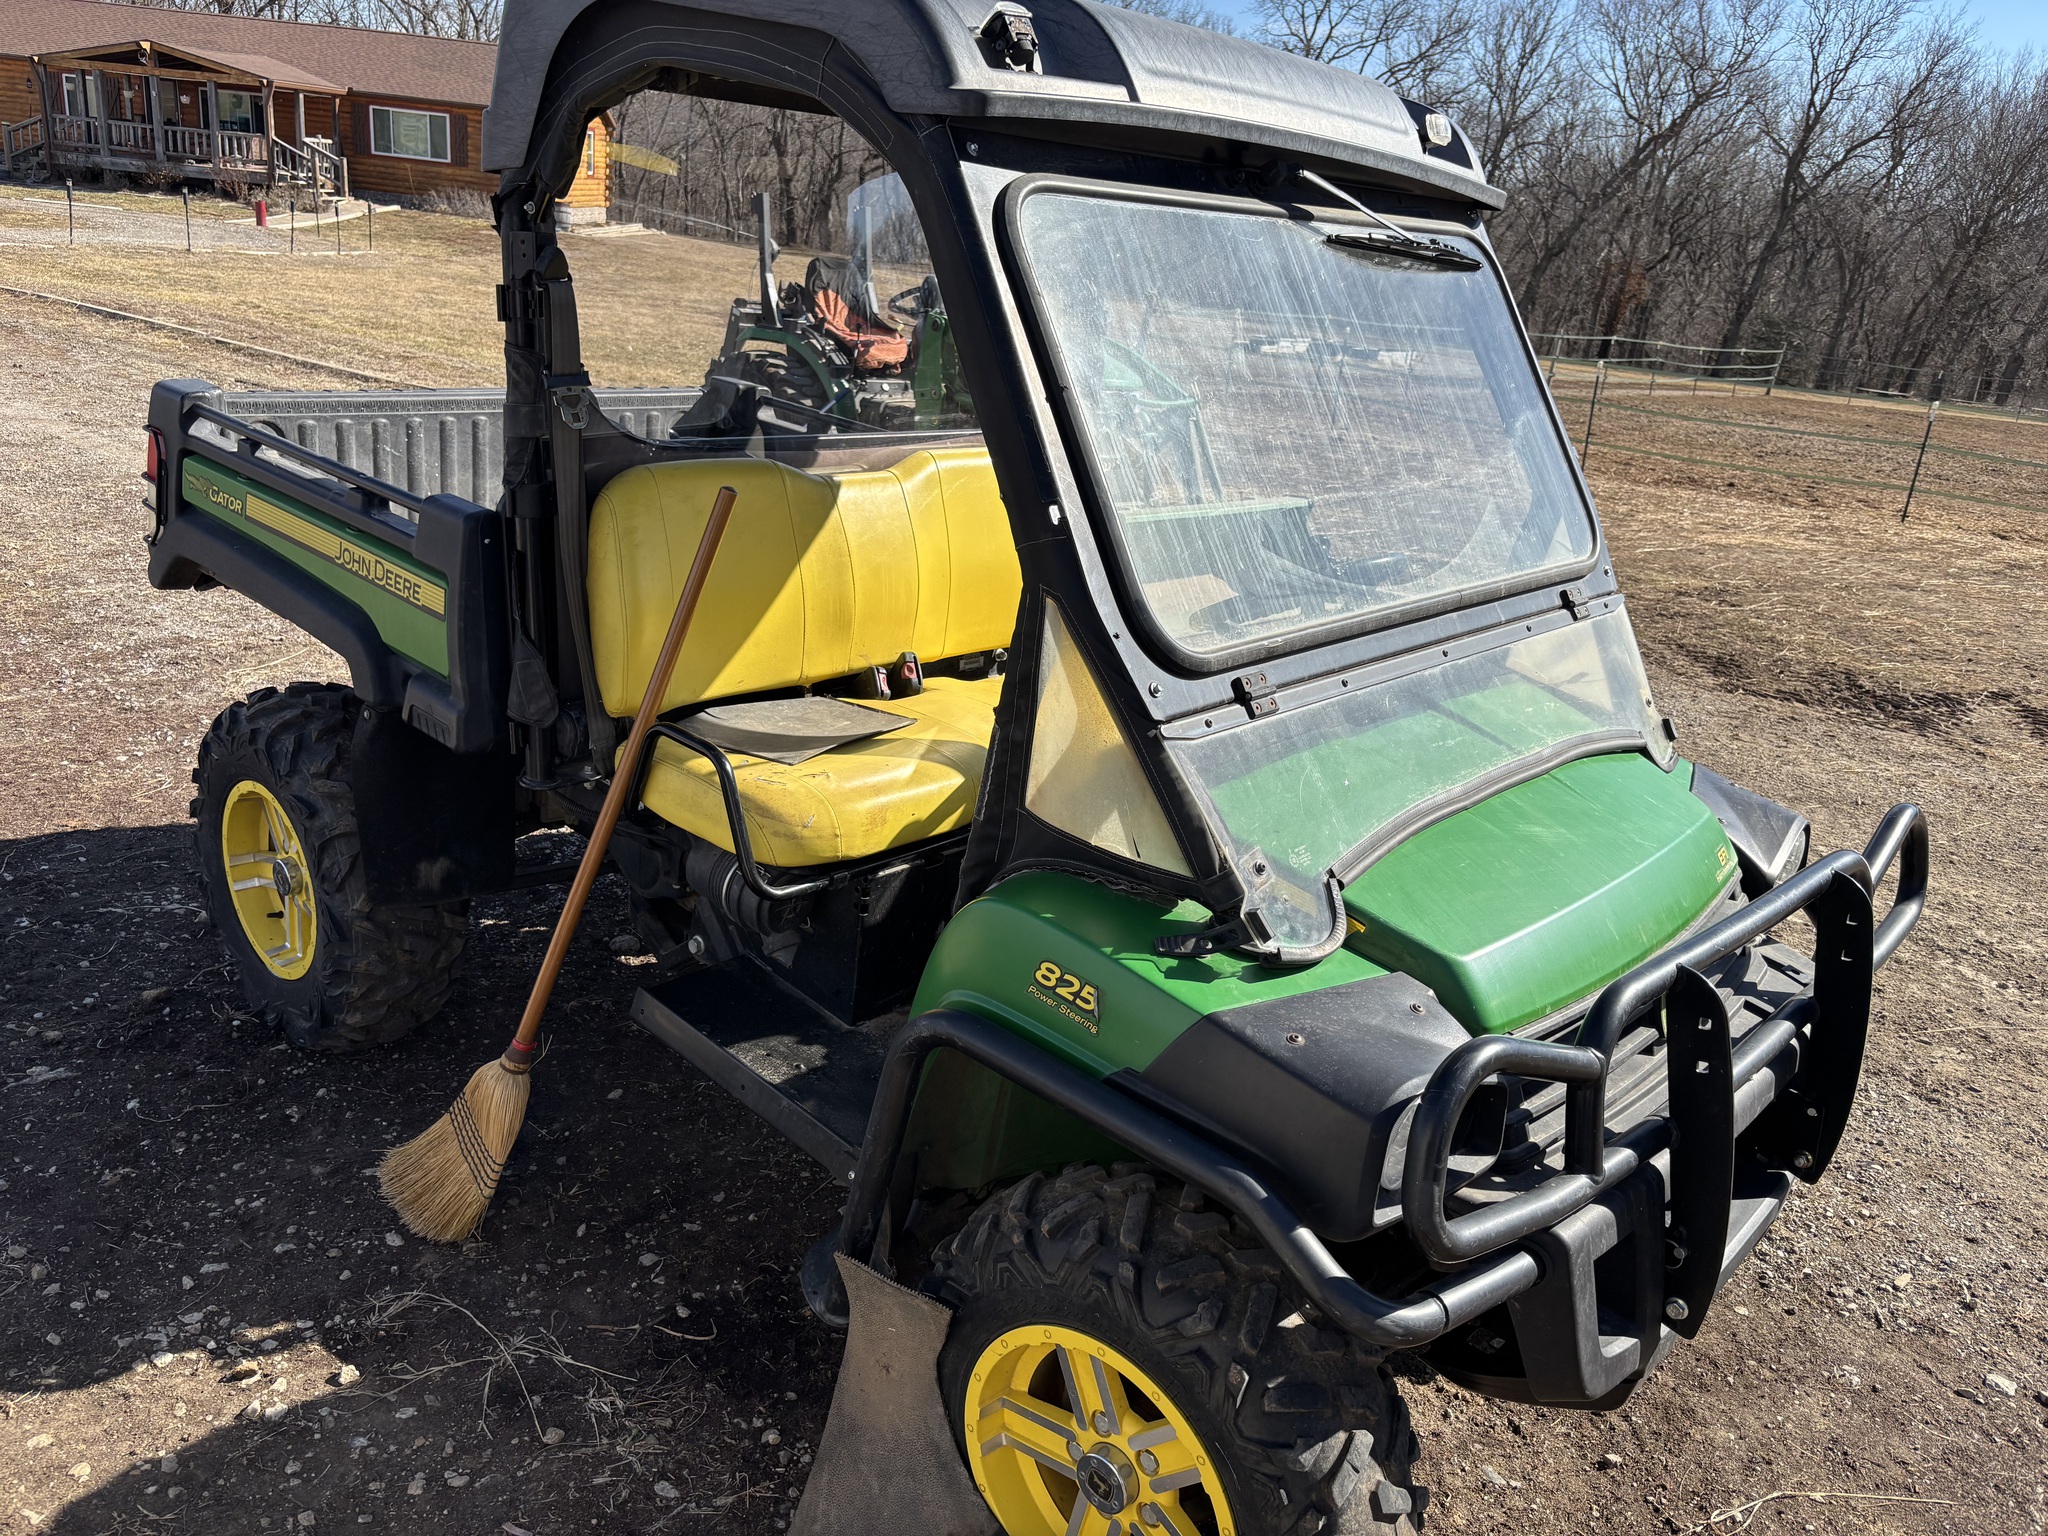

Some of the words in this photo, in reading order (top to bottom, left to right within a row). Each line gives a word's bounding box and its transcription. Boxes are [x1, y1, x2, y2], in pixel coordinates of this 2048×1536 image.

[209, 486, 243, 515] GATOR
[335, 541, 371, 577] JOHN
[374, 558, 422, 604] DEERE
[1027, 985, 1058, 1008] Power
[1058, 1003, 1099, 1034] Steering
[1035, 961, 1096, 1011] 825
